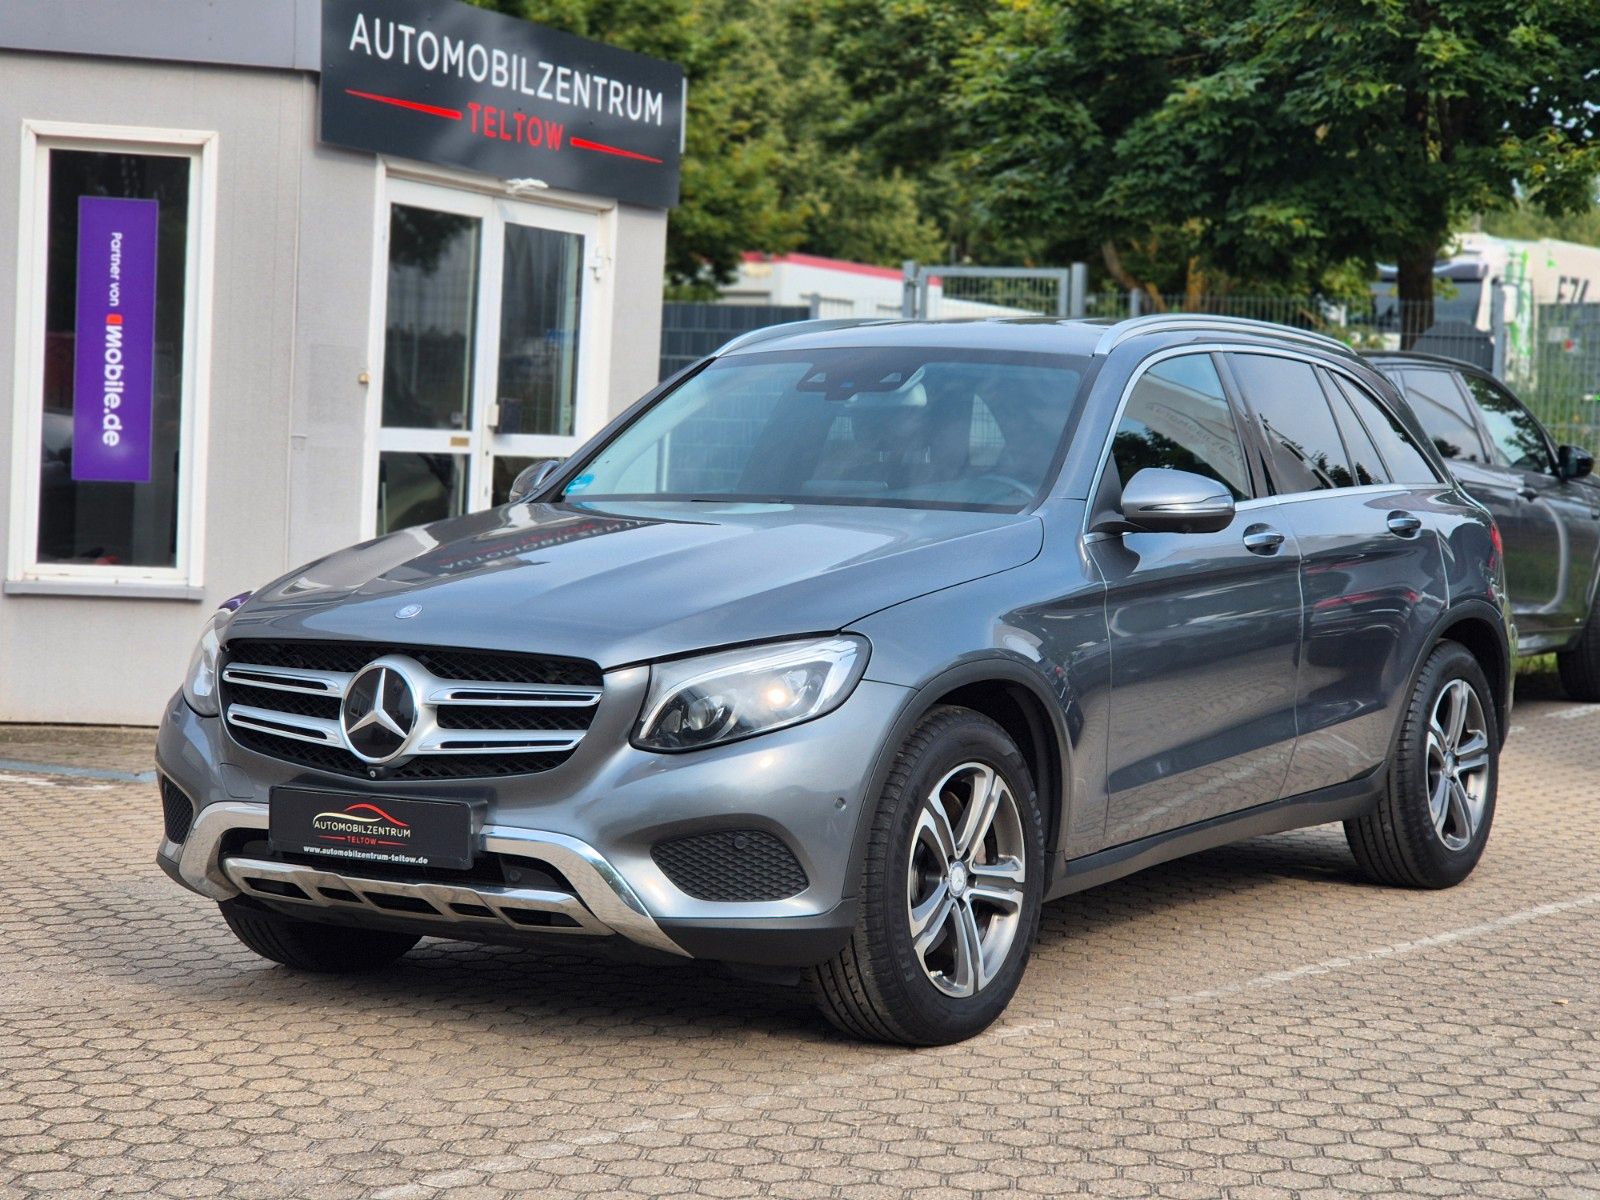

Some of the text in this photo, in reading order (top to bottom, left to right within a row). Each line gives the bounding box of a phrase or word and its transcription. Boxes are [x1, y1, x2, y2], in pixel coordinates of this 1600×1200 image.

[349, 13, 664, 127] AUTOMOBILZENTRUM
[467, 101, 565, 151] TELTOW
[110, 231, 123, 279] Partner
[109, 282, 121, 307] von
[314, 821, 411, 837] AUTOMOBILZENTRUM
[346, 835, 377, 845] TELTOW
[303, 845, 428, 864] www.automobilzentrum-teltow.de
